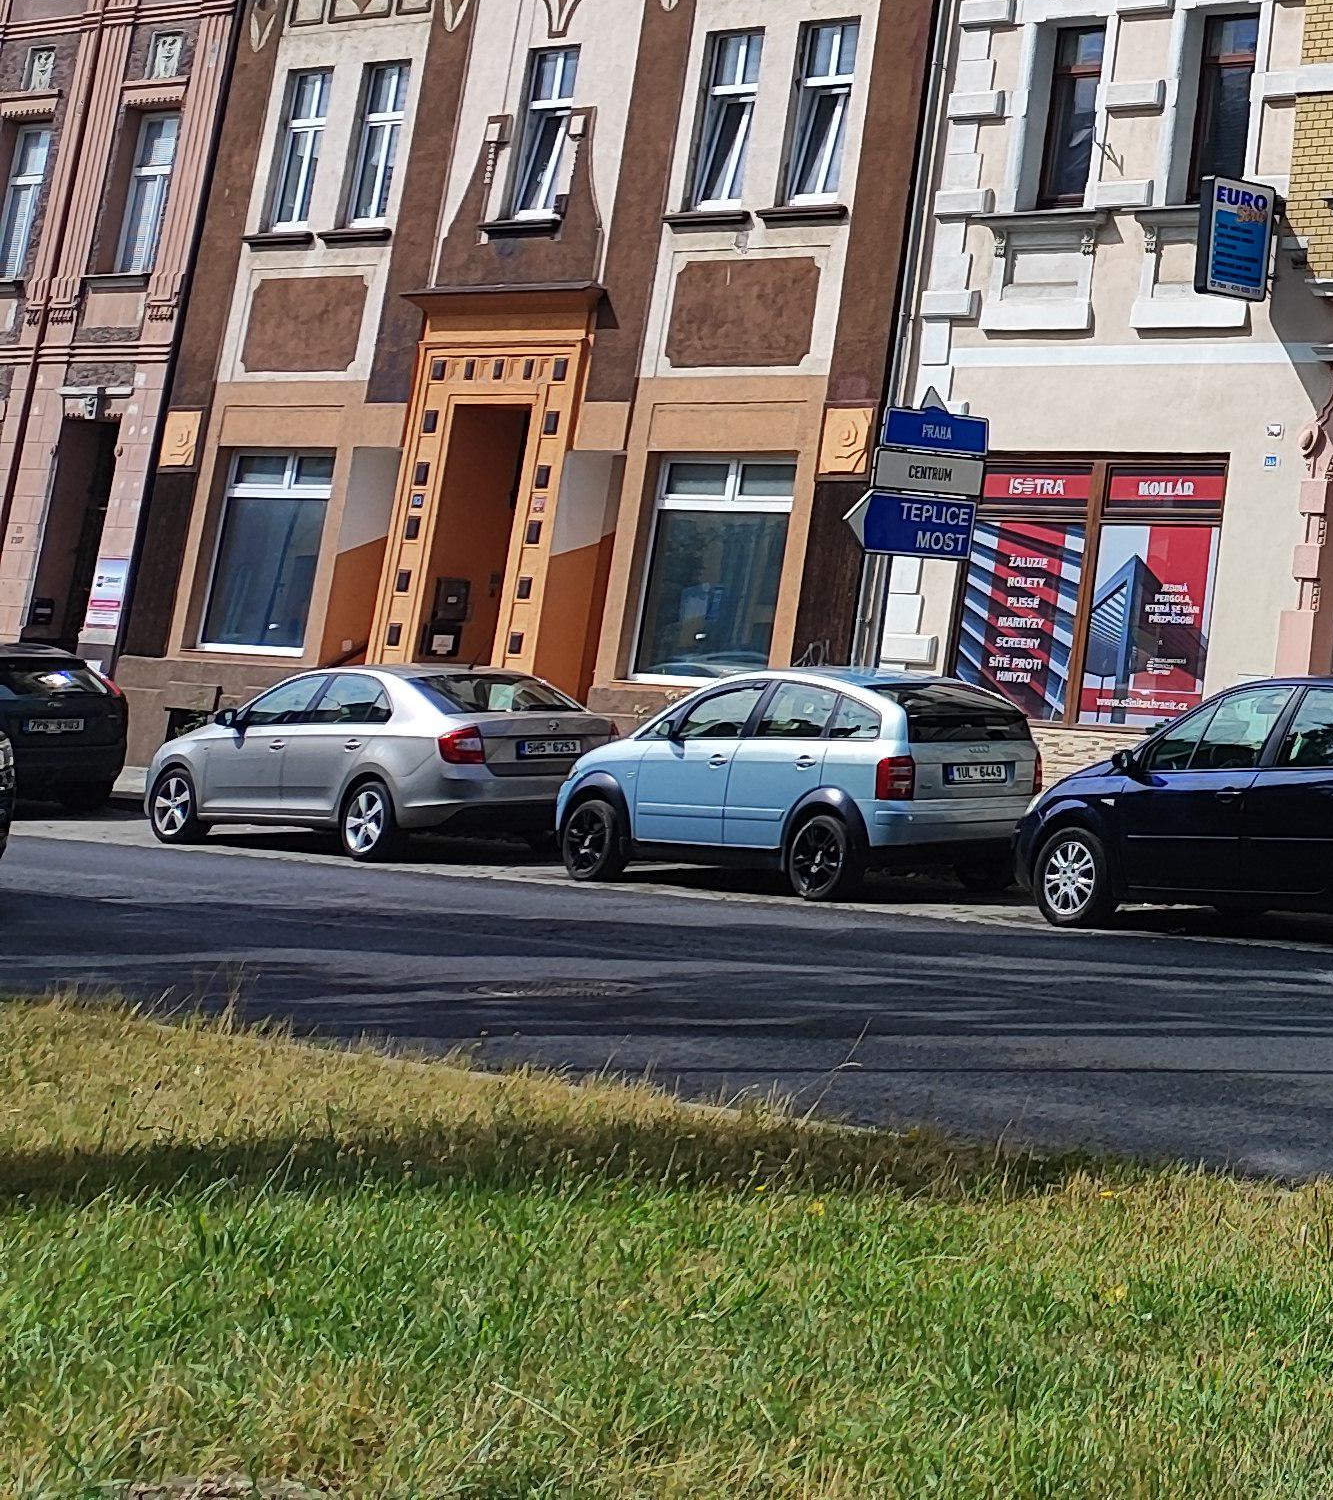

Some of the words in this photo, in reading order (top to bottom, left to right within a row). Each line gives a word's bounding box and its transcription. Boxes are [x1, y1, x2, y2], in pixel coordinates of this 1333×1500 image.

[1216, 185, 1267, 212] EURO
[922, 423, 952, 440] PRAHA
[908, 464, 953, 482] CENTRUM
[1137, 478, 1195, 496] KOLLÁR
[900, 502, 971, 526] TEPLICE
[915, 530, 968, 552] MOST
[1008, 553, 1049, 568] ŽALUZIE
[1006, 576, 1046, 588] ROLETY
[1006, 595, 1041, 609] PLISSÉ
[997, 615, 1045, 629] MARKÝZY
[995, 636, 1041, 649] SCREENY
[988, 654, 1010, 668] SÍTĚ
[1011, 658, 1042, 670] PROTI
[996, 670, 1032, 683] HMYZU
[552, 741, 577, 752] 6253
[956, 766, 973, 779] 1UL
[979, 765, 1002, 778] 6449
